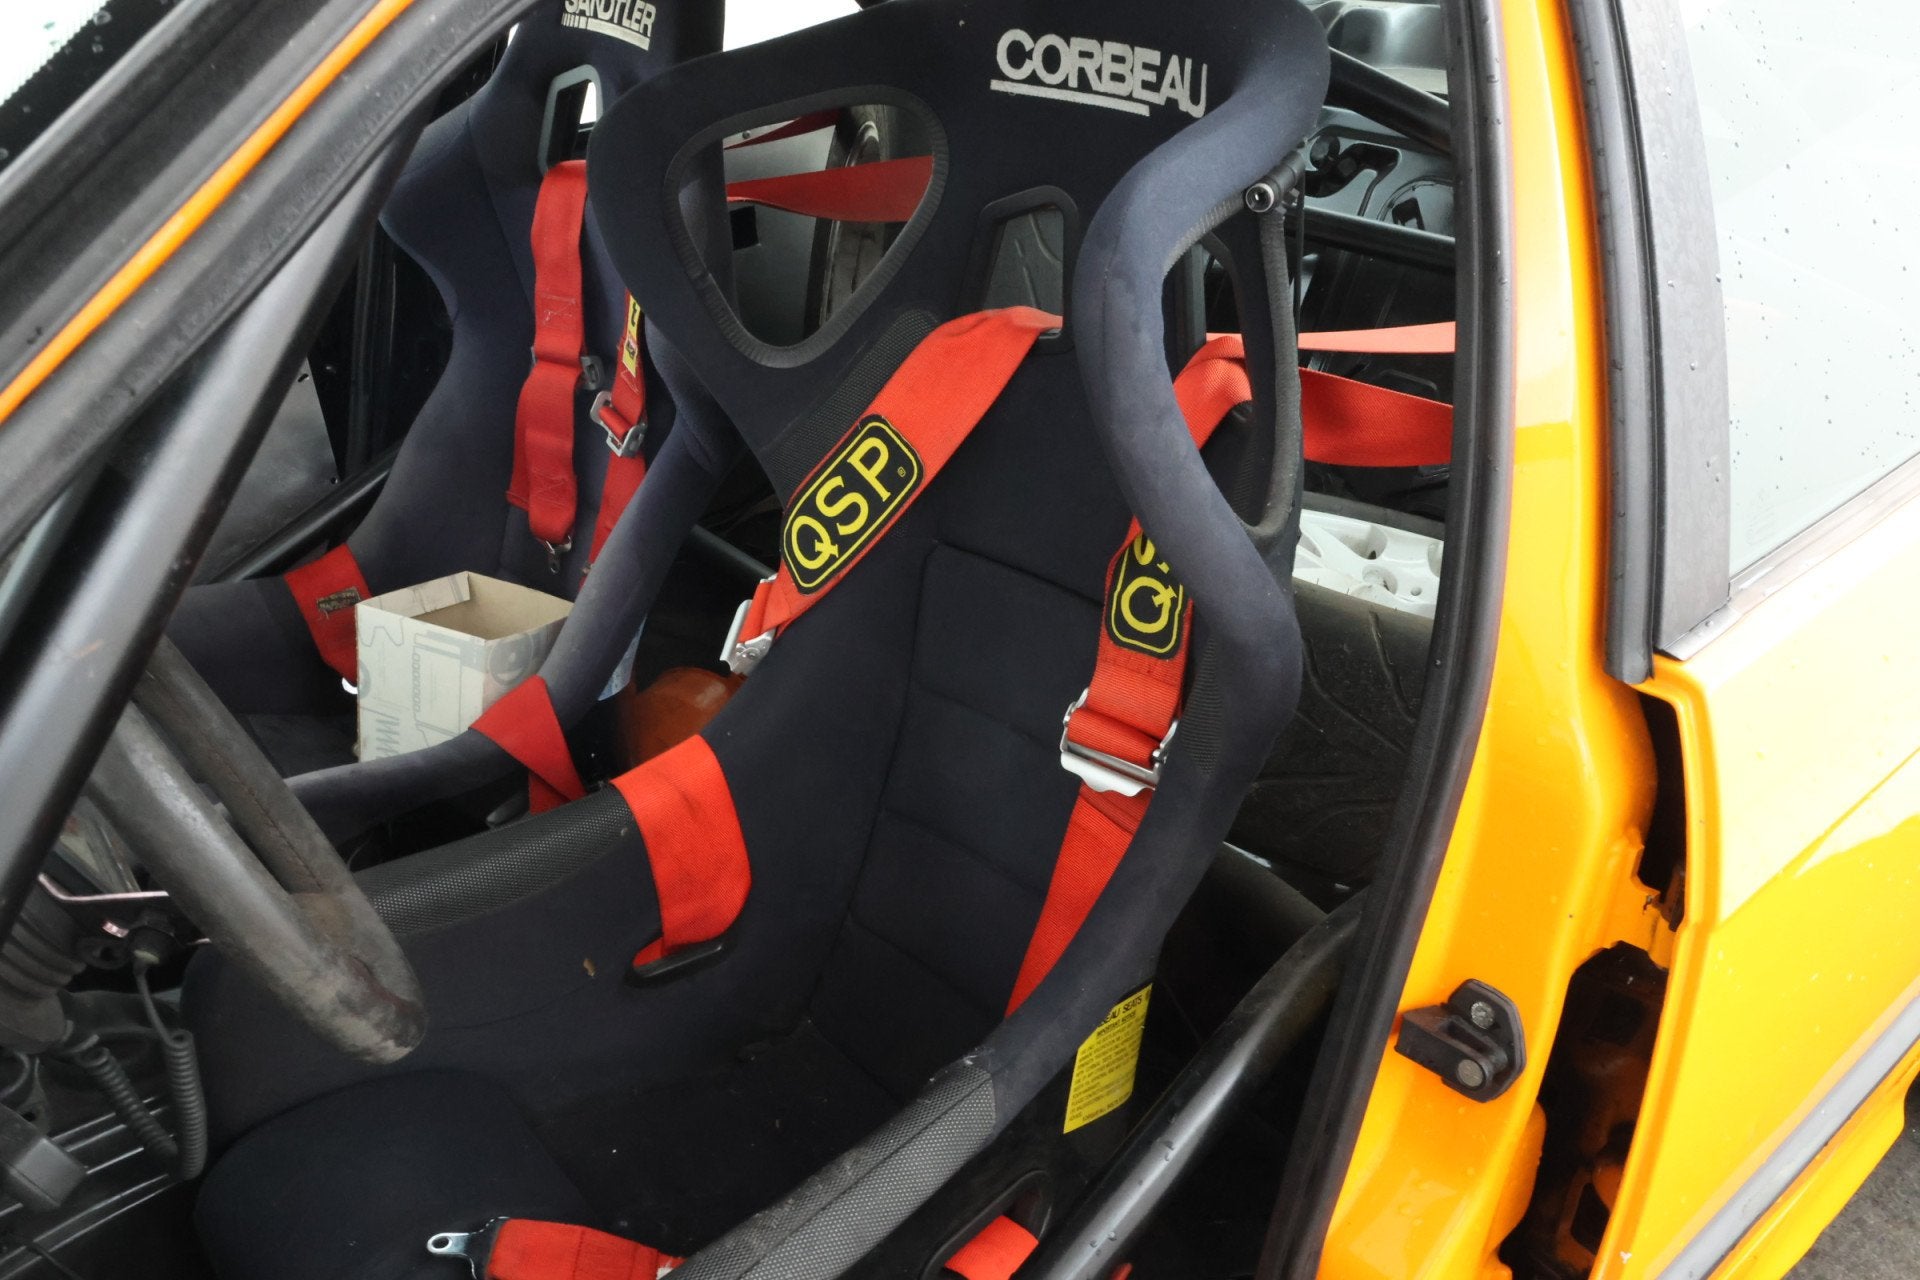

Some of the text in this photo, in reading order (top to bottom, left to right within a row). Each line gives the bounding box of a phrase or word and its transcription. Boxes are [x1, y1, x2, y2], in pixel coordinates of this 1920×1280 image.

[563, 0, 657, 37] SANDTLER
[996, 28, 1208, 119] CORBEAU
[791, 437, 892, 570] QSP
